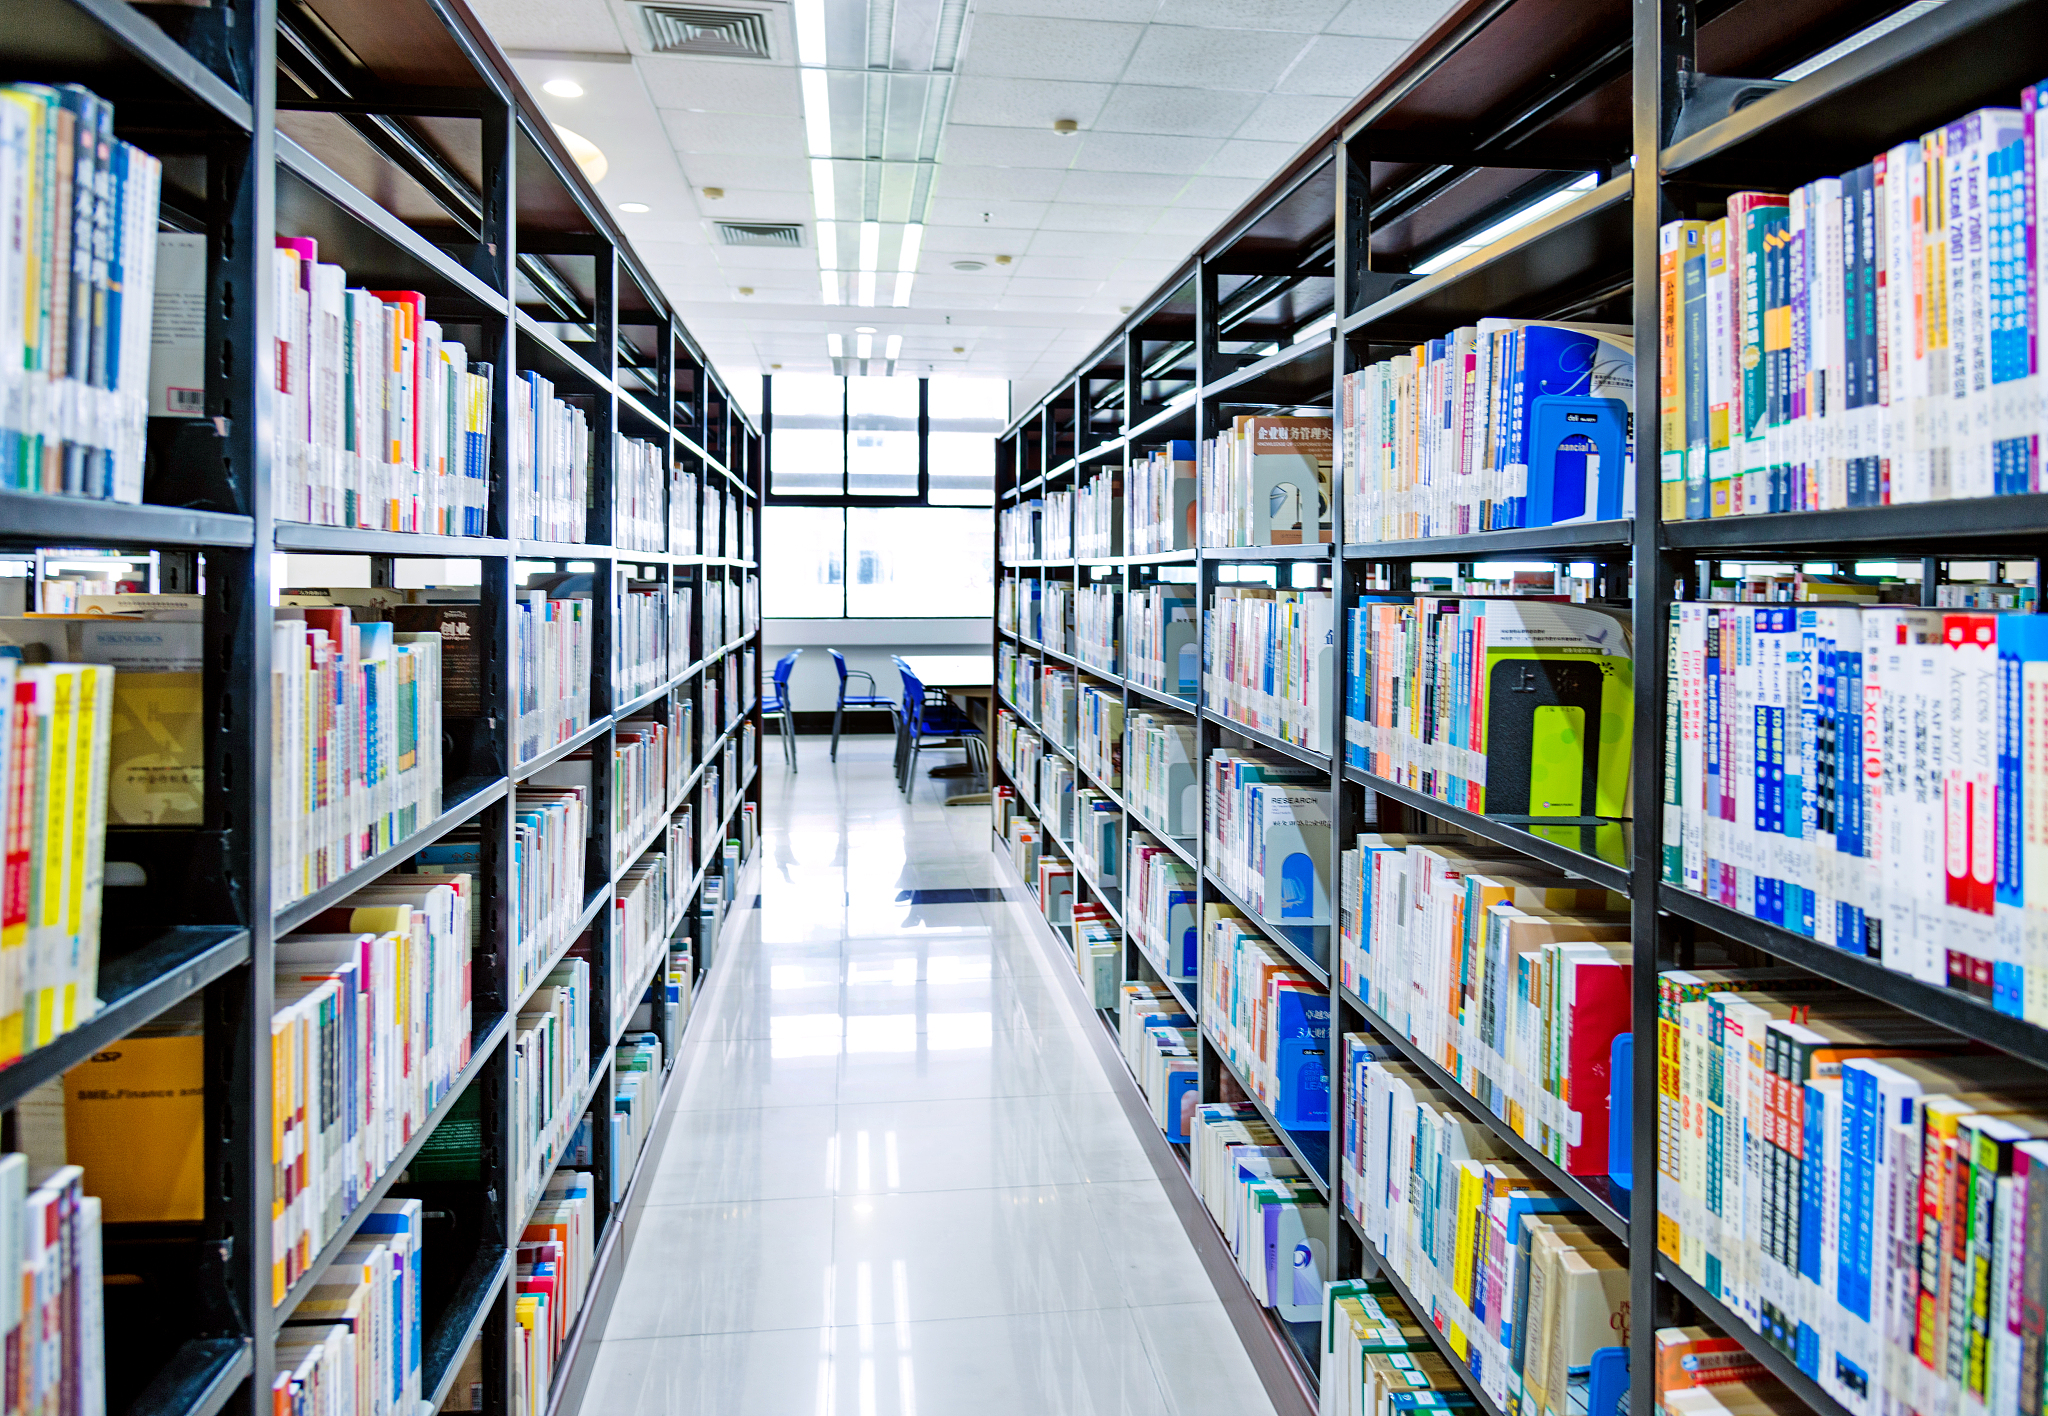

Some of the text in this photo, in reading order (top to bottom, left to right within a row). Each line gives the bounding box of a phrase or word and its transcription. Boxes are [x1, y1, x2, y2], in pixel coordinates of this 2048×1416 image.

[1669, 621, 1680, 676] Excel
[1802, 632, 1817, 704] Excel
[1864, 685, 1882, 752] Excel
[1271, 797, 1318, 805] RESEARCH
[1661, 1060, 1669, 1094] 2007
[1671, 1027, 1680, 1100] Excel 2007
[1923, 1131, 1940, 1211] EXCEL
